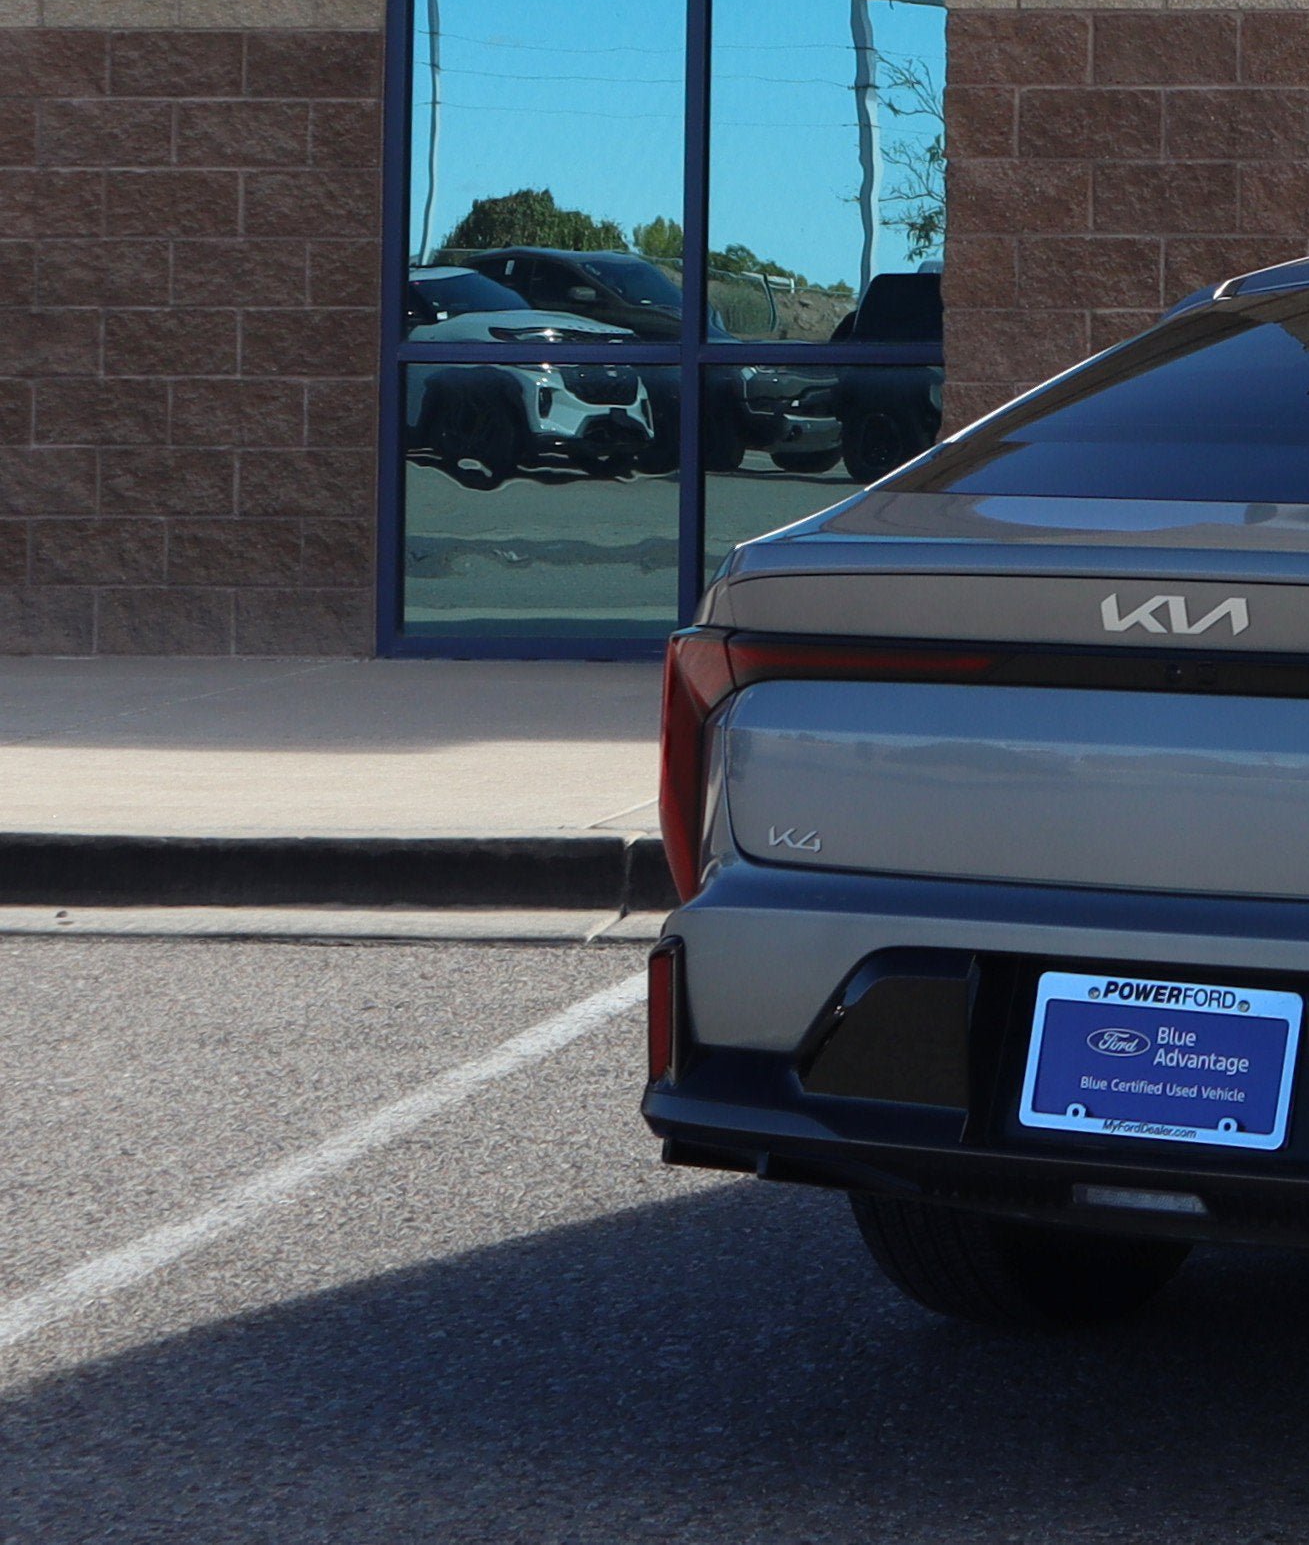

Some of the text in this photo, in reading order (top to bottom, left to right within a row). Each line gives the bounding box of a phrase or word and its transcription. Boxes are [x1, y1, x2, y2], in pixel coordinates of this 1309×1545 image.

[1101, 593, 1249, 636] KIA
[769, 825, 821, 853] K4
[1103, 981, 1236, 1009] POWERFORD
[1098, 1031, 1139, 1053] Ford
[1157, 1026, 1197, 1047] Blue
[1153, 1049, 1250, 1075] Advantage
[1080, 1075, 1245, 1102] Blue Certified Used Vehicle
[1103, 1119, 1197, 1139] MyFordDealer.com
